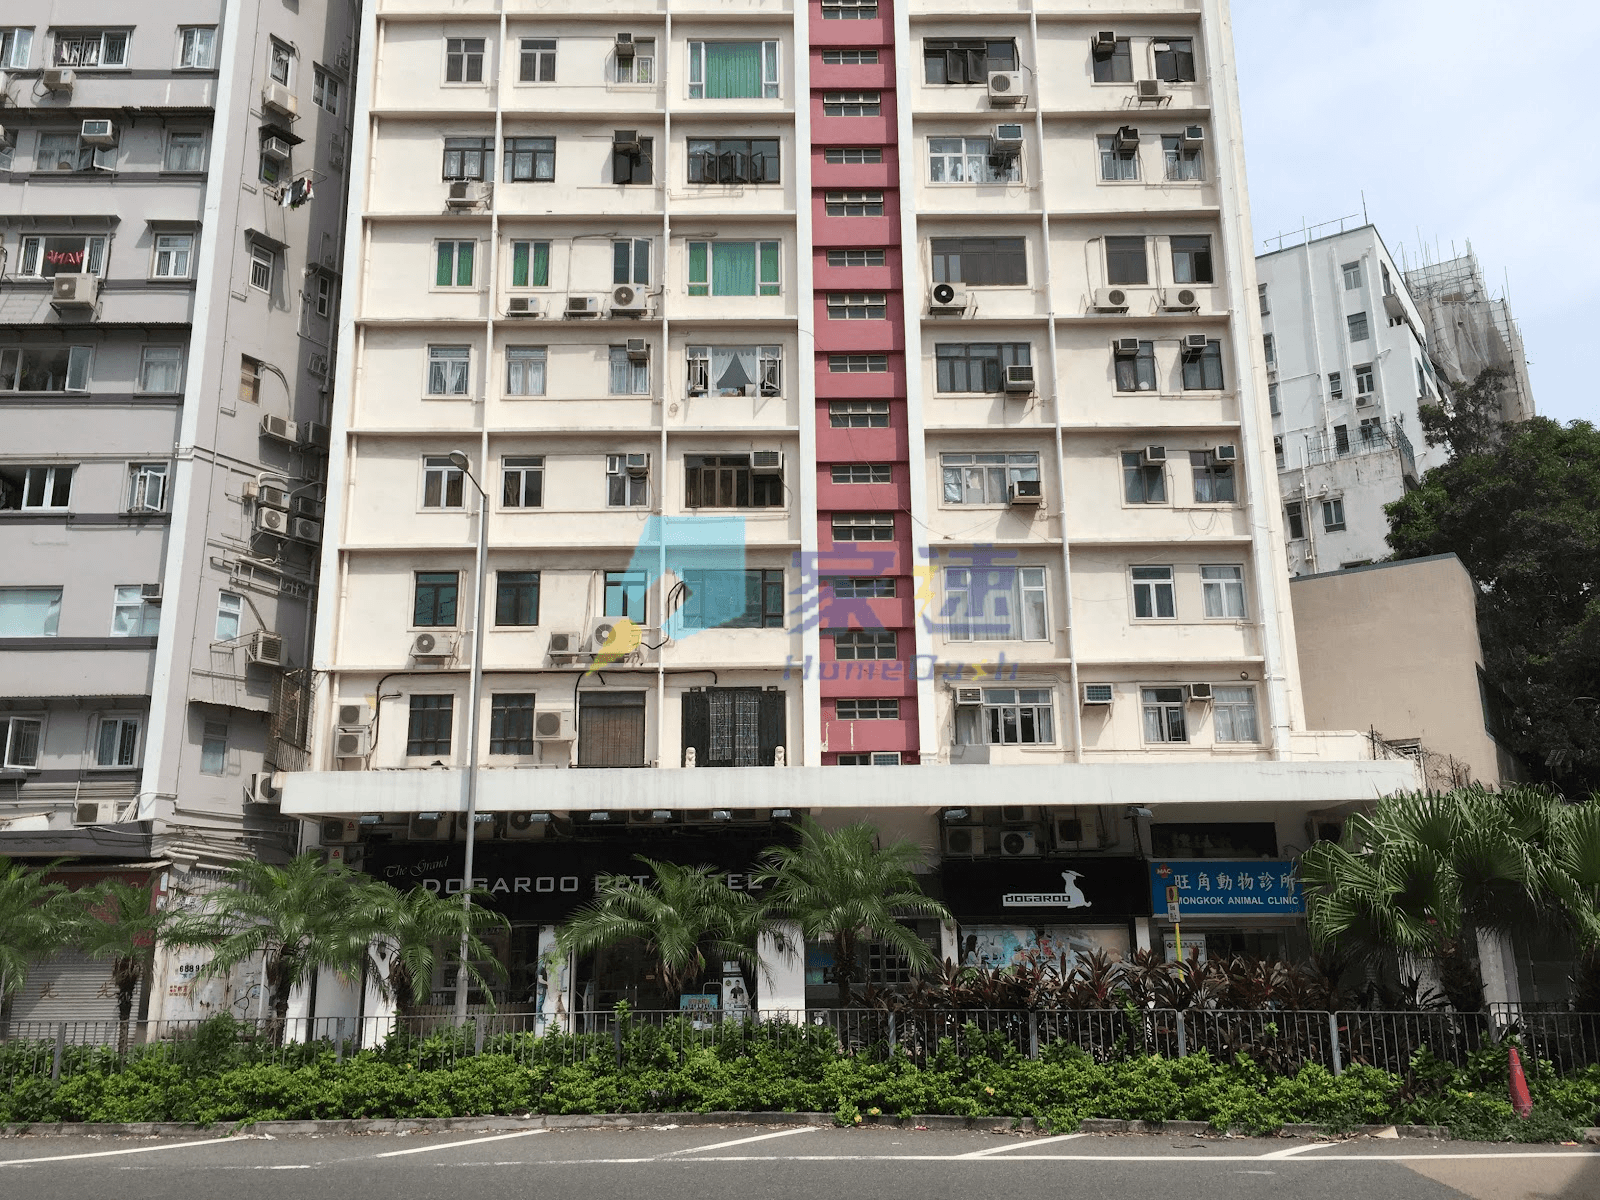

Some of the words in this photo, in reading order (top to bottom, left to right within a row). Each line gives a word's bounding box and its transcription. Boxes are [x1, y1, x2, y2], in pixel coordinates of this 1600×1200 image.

[384, 864, 408, 878] The
[410, 856, 449, 877] Grand
[422, 876, 579, 894] DOGAROO
[1174, 872, 1297, 891] 旺角動物診所
[1227, 896, 1265, 905] ANIMAL
[1267, 896, 1299, 905] CLINIC
